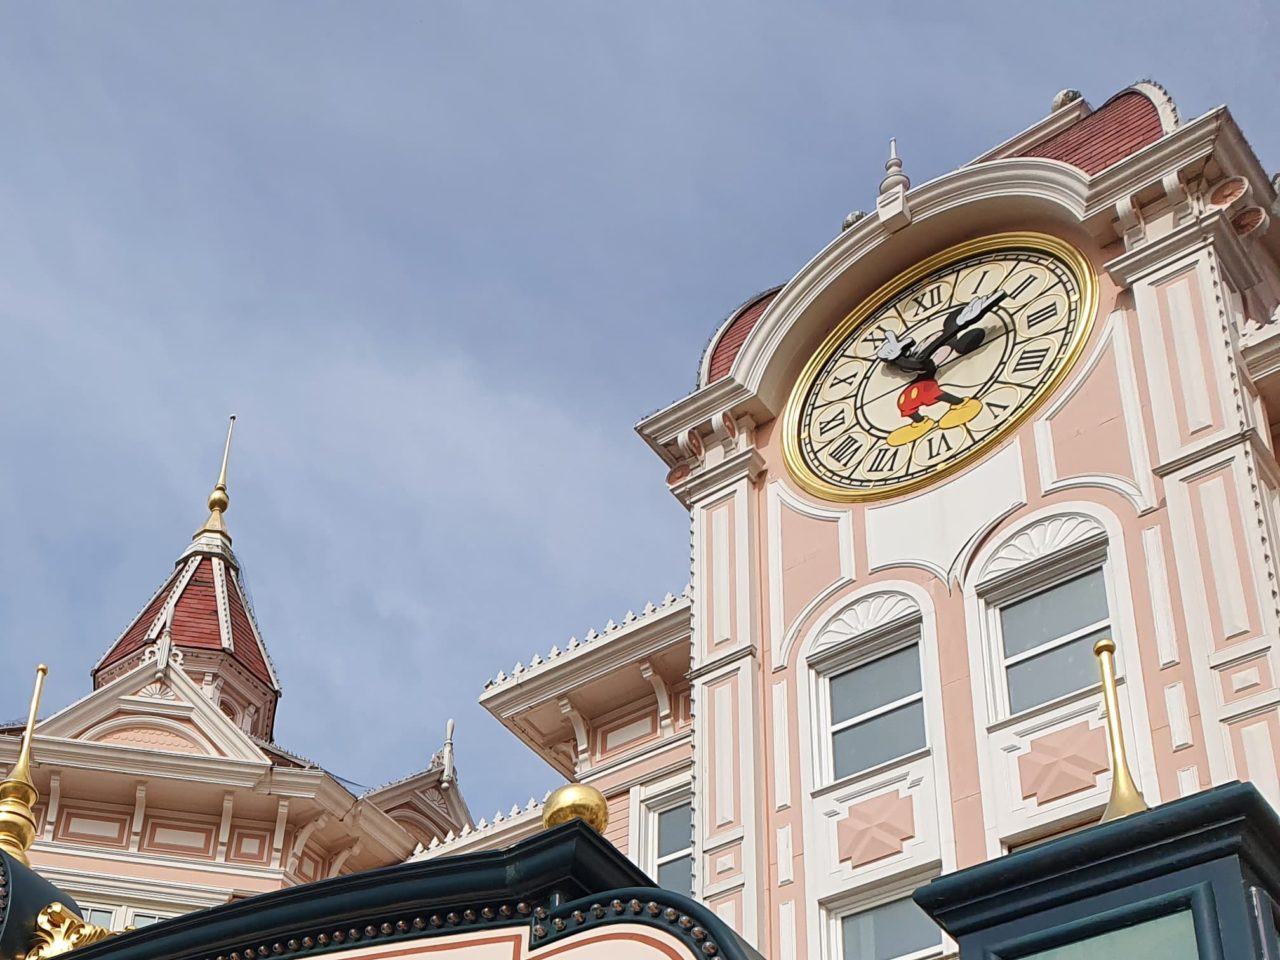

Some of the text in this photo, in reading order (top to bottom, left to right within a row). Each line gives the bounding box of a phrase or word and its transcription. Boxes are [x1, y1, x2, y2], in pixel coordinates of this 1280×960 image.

[971, 270, 989, 294] I
[1008, 274, 1038, 300] II
[912, 285, 943, 318] XII
[1027, 301, 1058, 330] III
[1012, 346, 1051, 374] IIII
[829, 371, 858, 389] X
[819, 407, 845, 437] IX
[985, 402, 1010, 420] V
[828, 434, 863, 468] VIII
[867, 448, 899, 472] VII
[928, 432, 953, 460] VI
